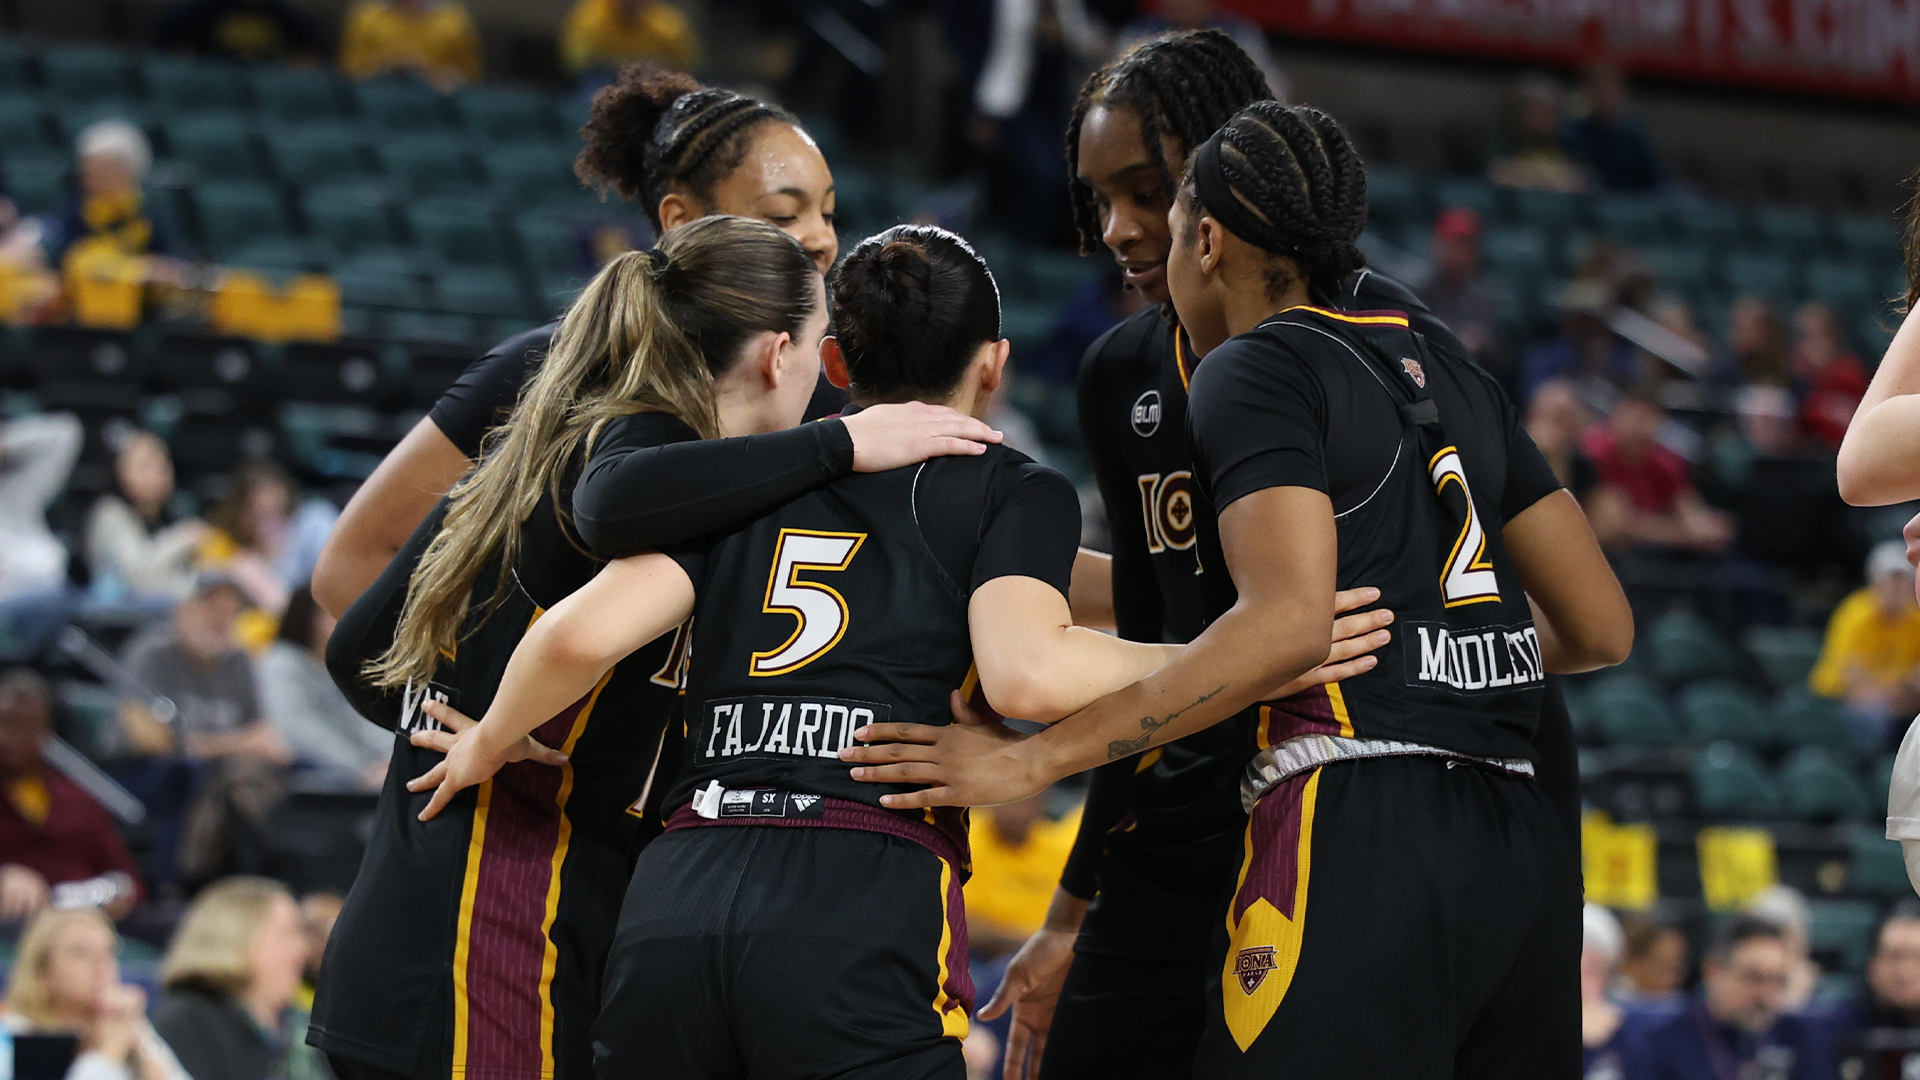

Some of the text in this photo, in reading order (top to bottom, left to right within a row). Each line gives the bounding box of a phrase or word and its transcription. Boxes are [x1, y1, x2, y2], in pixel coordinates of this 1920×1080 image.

[1134, 404, 1160, 424] BLM
[1428, 446, 1502, 609] 2
[748, 528, 868, 677] 5
[705, 702, 874, 758] FAJARDO
[1231, 952, 1279, 976] IONA
